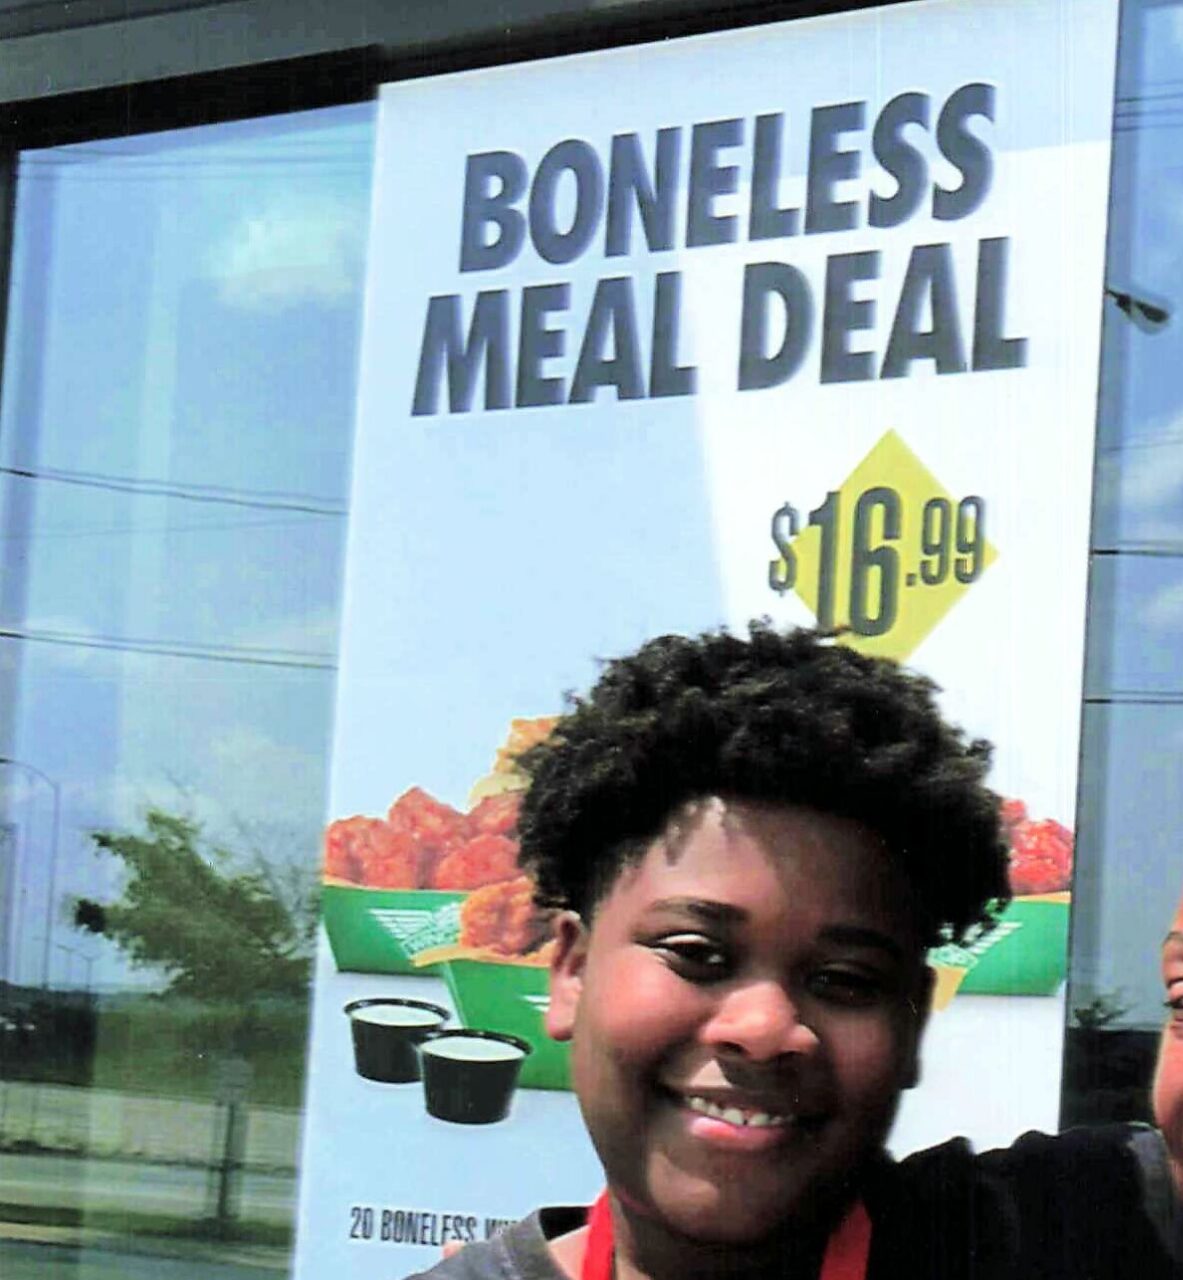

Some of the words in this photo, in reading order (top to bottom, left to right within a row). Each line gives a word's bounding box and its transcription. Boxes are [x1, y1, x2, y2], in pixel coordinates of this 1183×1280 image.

[458, 82, 997, 273] BONELESS
[411, 271, 698, 416] MEAL
[737, 236, 1029, 392] DEAL
[768, 485, 986, 638] $16.99
[350, 1207, 373, 1239] 20
[381, 1209, 477, 1246] BONELESS
